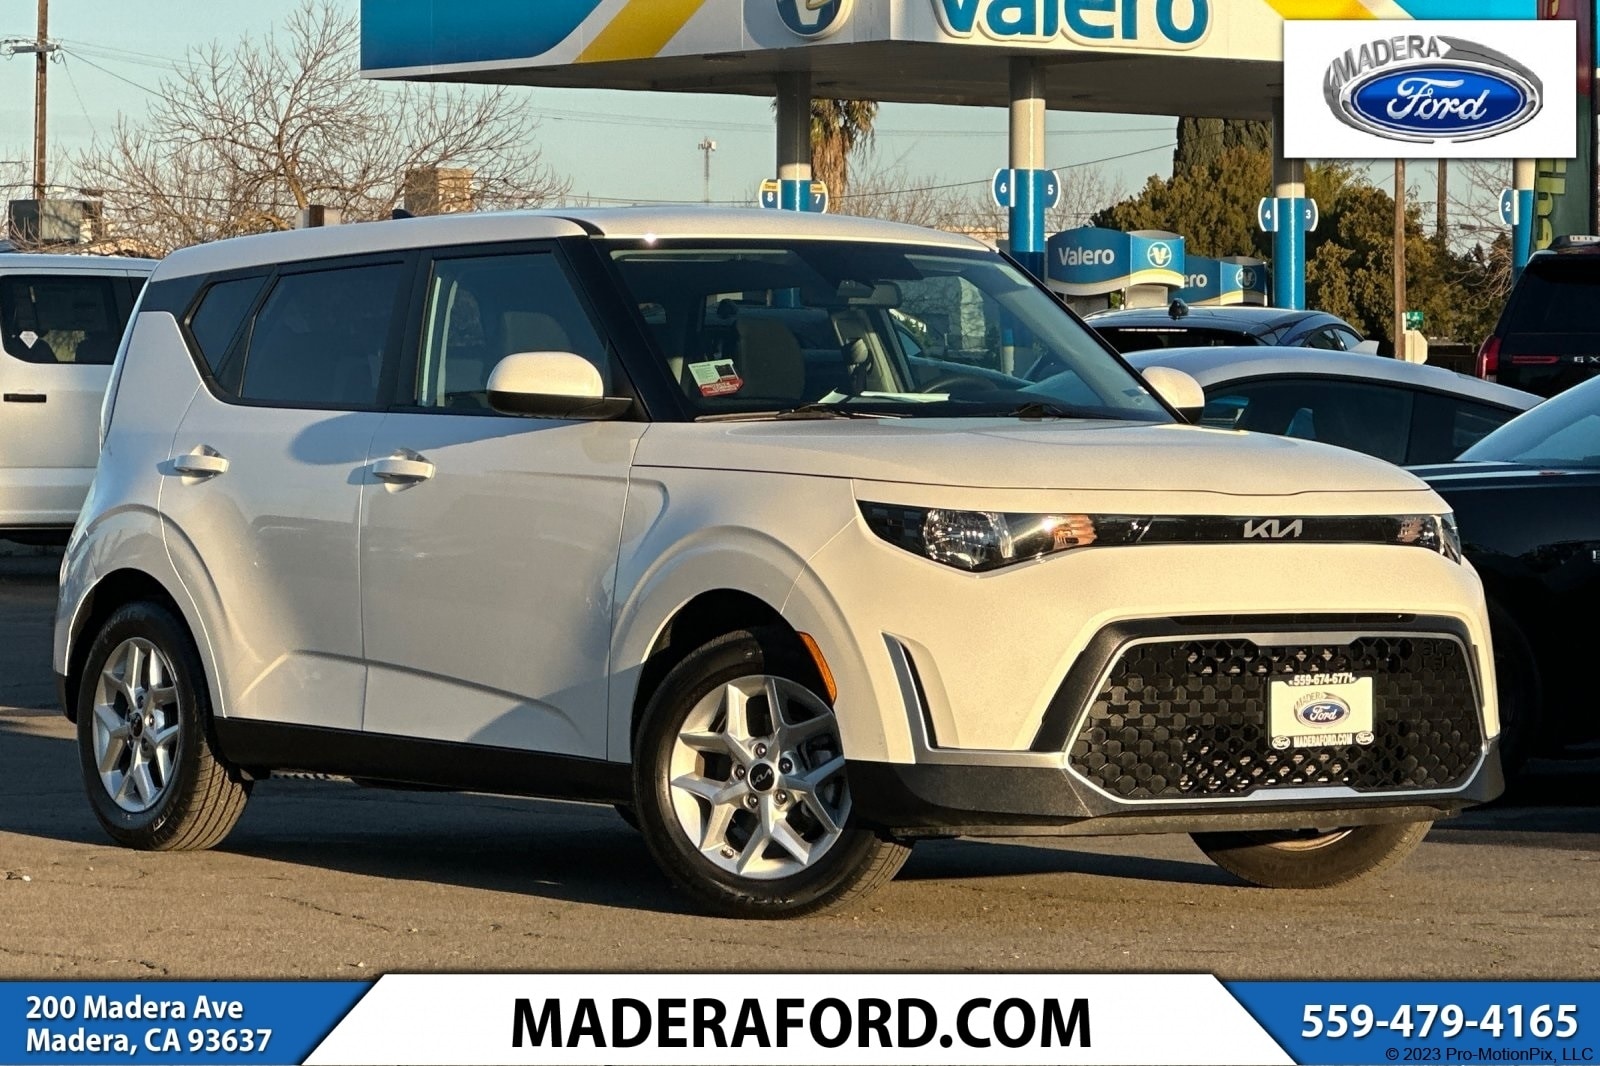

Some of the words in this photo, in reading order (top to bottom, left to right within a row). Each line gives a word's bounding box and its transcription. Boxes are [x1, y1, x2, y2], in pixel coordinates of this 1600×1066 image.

[1000, 183, 1007, 193] 6
[1047, 184, 1054, 195] 5
[767, 192, 773, 202] 8
[815, 194, 821, 204] 7
[1505, 201, 1511, 211] 2
[1264, 210, 1271, 219] 4
[1305, 210, 1311, 219] 3
[1058, 246, 1115, 266] Valero
[1243, 519, 1303, 538] KIA
[1310, 705, 1337, 721] Ford
